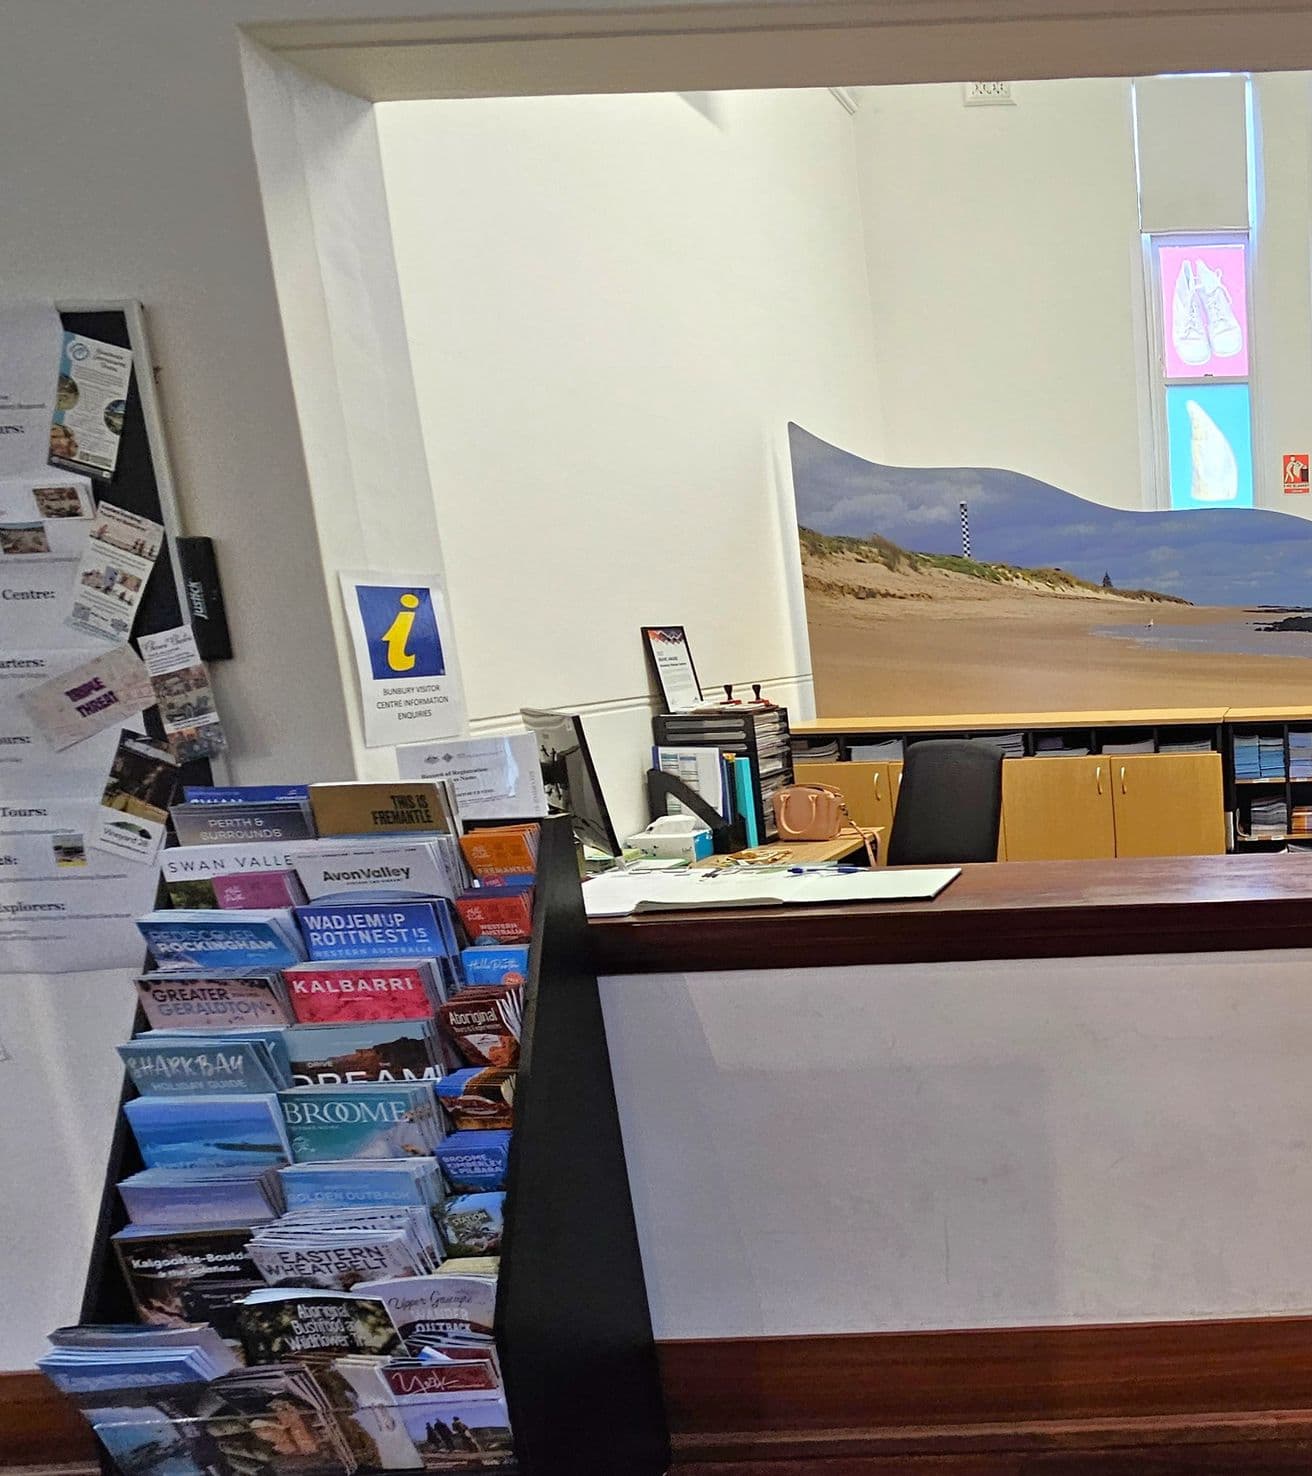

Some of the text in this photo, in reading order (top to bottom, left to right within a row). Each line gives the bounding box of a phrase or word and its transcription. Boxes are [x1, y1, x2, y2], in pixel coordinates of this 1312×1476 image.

[2, 589, 55, 601] Centre:
[383, 684, 440, 696] BUNBURY VISITOR
[75, 690, 119, 718] THREAT
[376, 696, 449, 710] CENTRE INFORMATION
[397, 710, 432, 721] ENQUIRIES
[1, 805, 47, 818] Tours:
[371, 810, 433, 825] FREMANTLE
[208, 818, 264, 828] PERTH &
[200, 828, 282, 840] SURROUNDS
[167, 855, 294, 873] SWAN VALLE
[303, 913, 406, 930] WADJEMUP
[310, 927, 427, 946] ROTTNEST IS
[156, 940, 277, 953] ROCKINGHAM
[293, 977, 414, 994] KALBARRI
[152, 988, 230, 1002] GREATER
[159, 1003, 266, 1016] GERALDTON
[449, 1008, 498, 1025] Aboriginal
[282, 1101, 408, 1124] BROOME
[279, 1247, 382, 1264] EASTERN
[264, 1258, 388, 1276] WHEATBELT
[297, 1303, 349, 1320] Aboriginal
